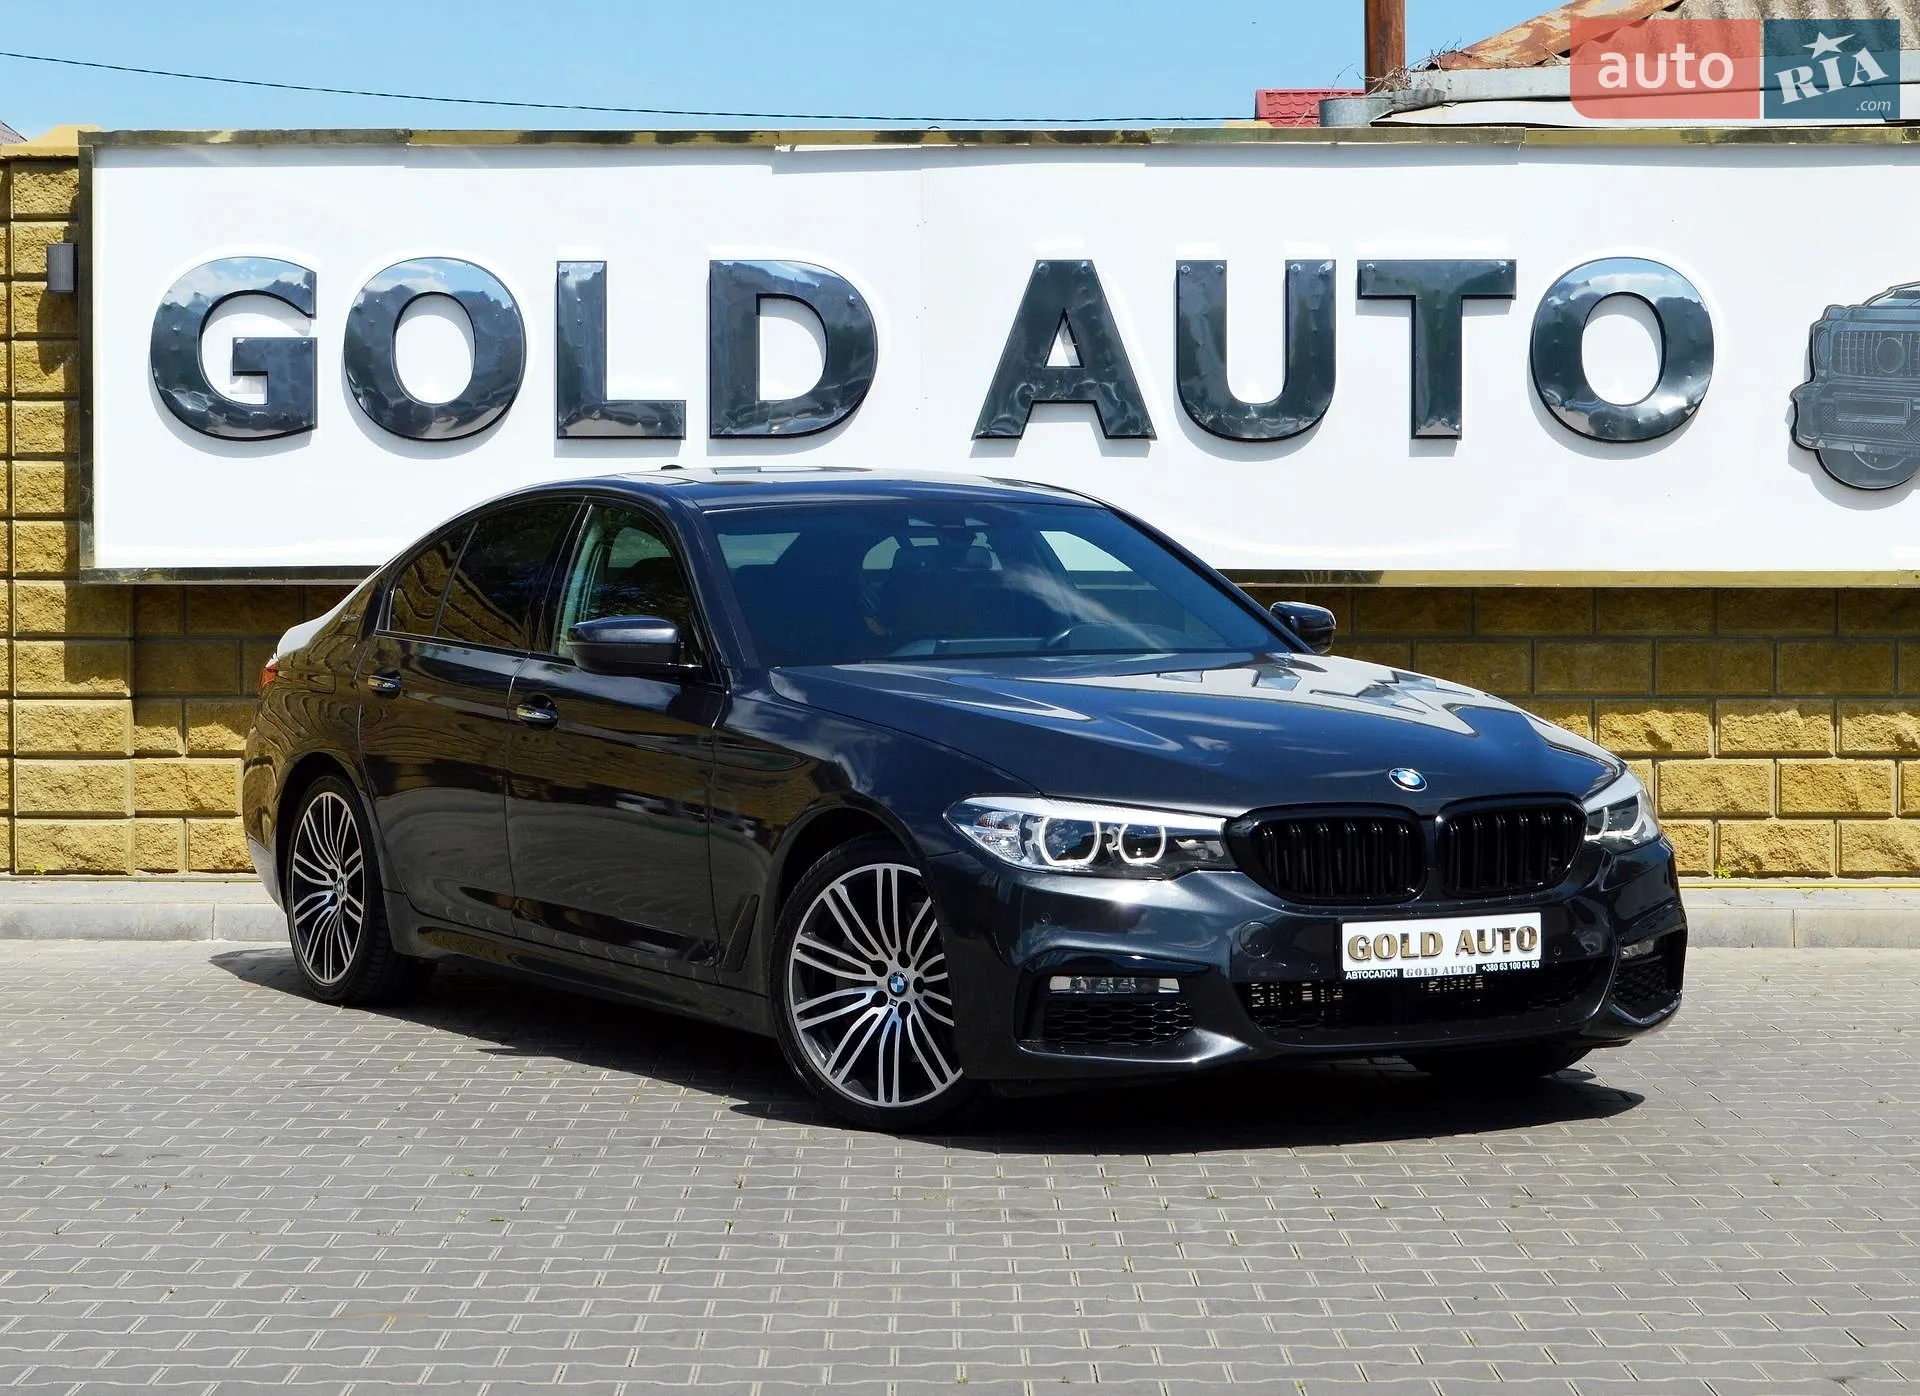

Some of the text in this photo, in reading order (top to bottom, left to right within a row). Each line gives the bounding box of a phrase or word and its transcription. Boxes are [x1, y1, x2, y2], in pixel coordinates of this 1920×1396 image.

[150, 256, 1715, 443] GOLD AUTO
[1348, 926, 1538, 960] GOLD AUTO
[1405, 965, 1474, 977] GOLD AUTO
[1481, 961, 1540, 972] +380 63 100 04 50
[1346, 970, 1398, 979] АВТОСАЛОН
